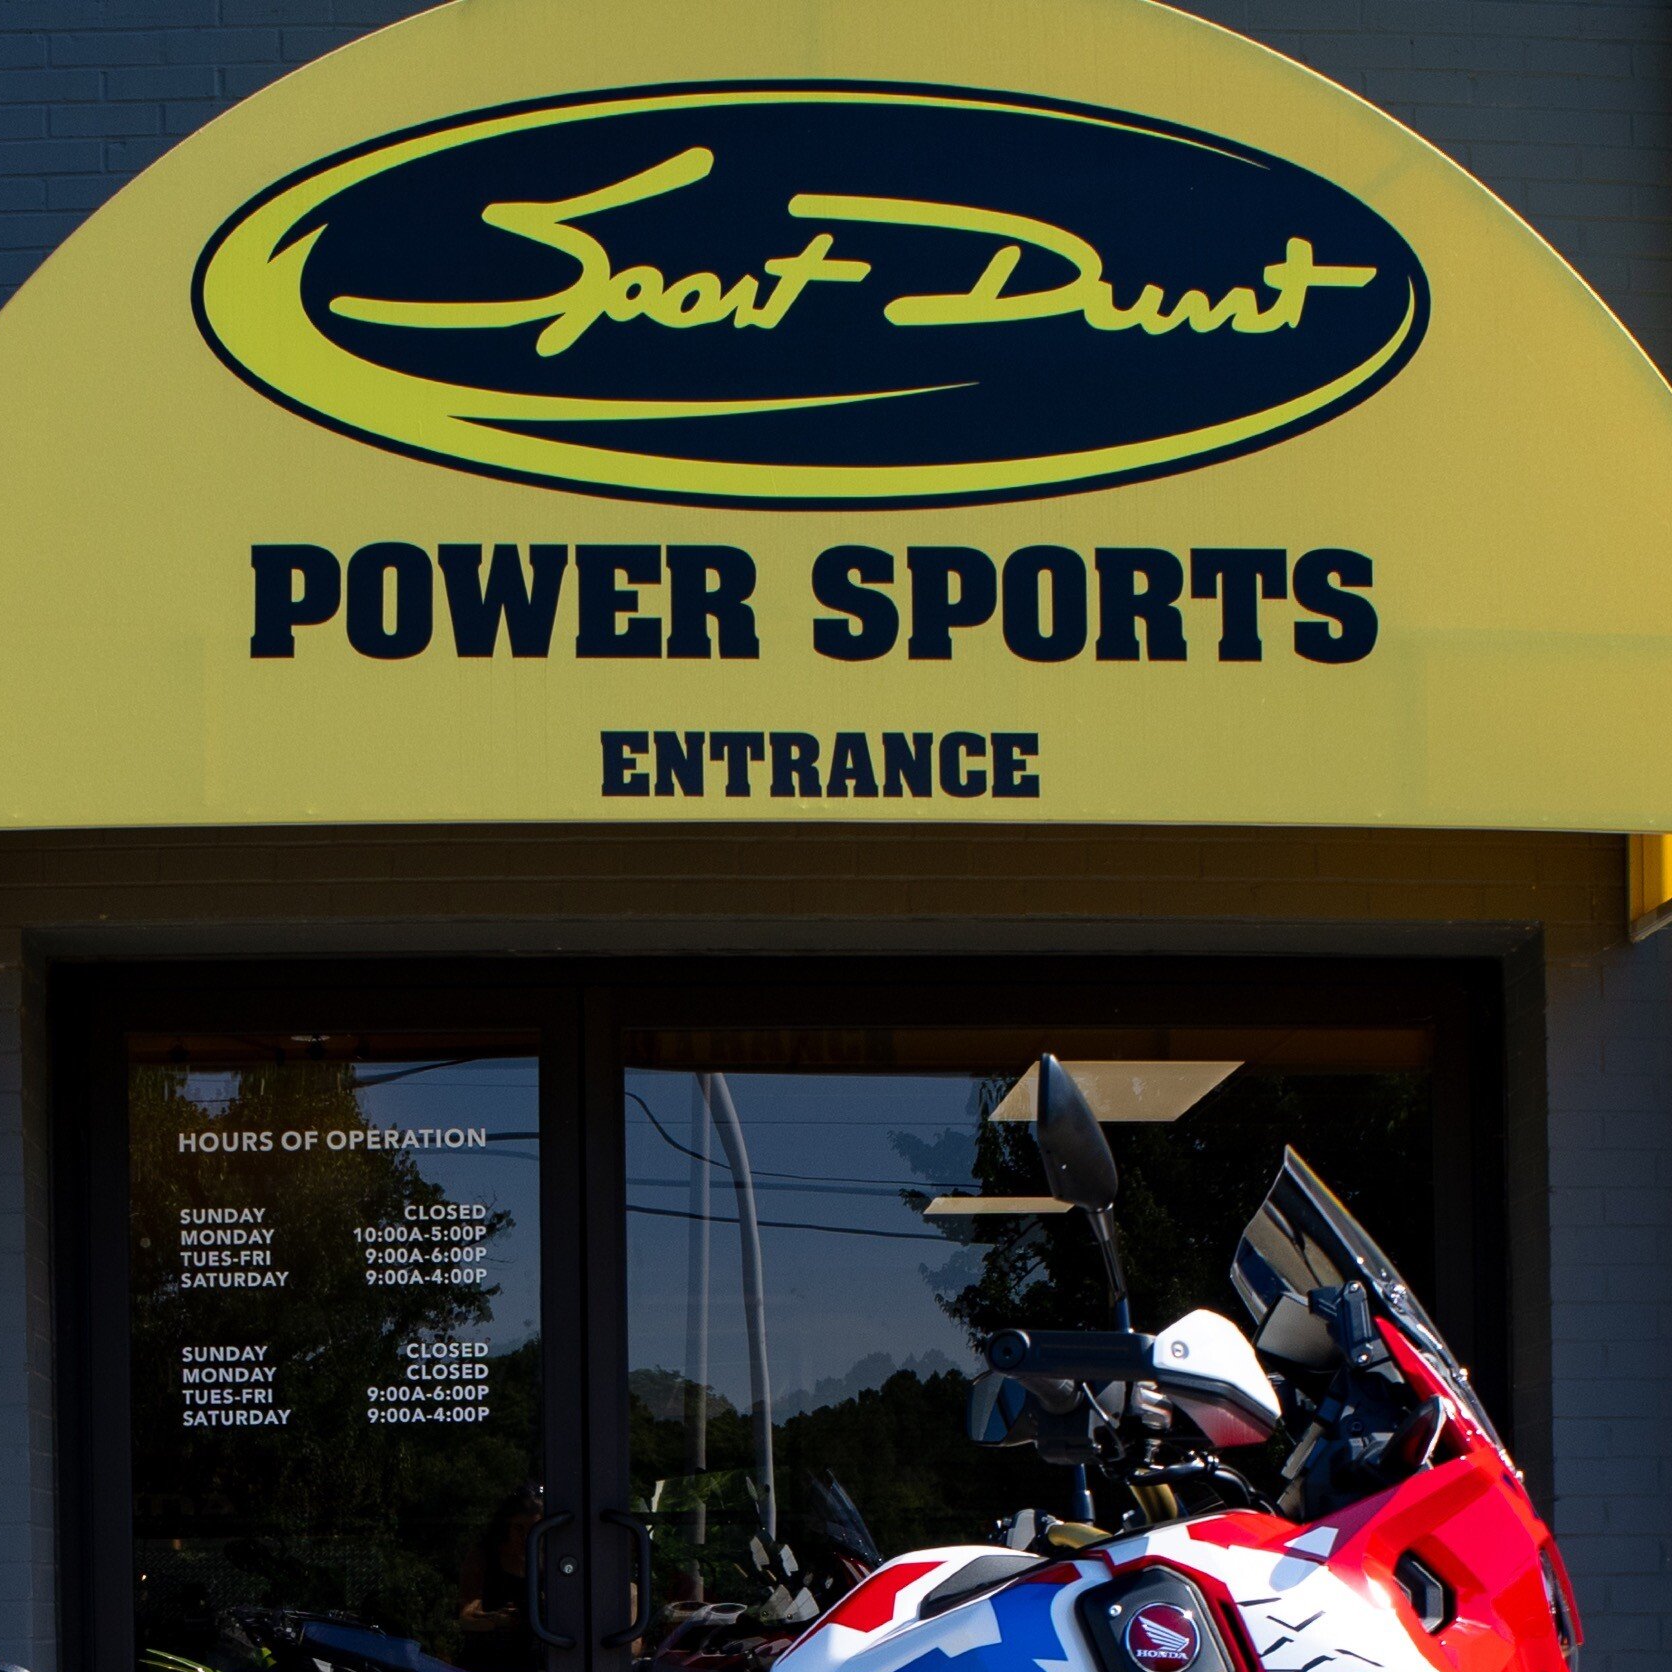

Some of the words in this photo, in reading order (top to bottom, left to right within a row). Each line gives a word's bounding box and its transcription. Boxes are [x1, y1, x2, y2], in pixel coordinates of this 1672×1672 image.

[250, 541, 760, 660] POWER
[811, 544, 1379, 665] SPORTS
[600, 730, 1040, 798] ENTRANCE
[178, 1131, 273, 1153] HOURS
[281, 1130, 318, 1151] OF
[327, 1127, 487, 1151] OPERATION
[180, 1208, 266, 1225] SUNDAY
[404, 1204, 487, 1221] CLOSED
[180, 1229, 275, 1246] MONDAY
[353, 1226, 487, 1243] 10:00A-5:00P
[181, 1251, 271, 1267] TUES-FRI
[366, 1247, 488, 1264] 9:00A-6:00P
[181, 1271, 289, 1288] SATURDAY
[366, 1269, 488, 1286] 9:00A-4:00P
[182, 1345, 268, 1362] SUNDAY
[406, 1342, 489, 1359] CLOSED
[182, 1367, 277, 1384] MONDAY
[406, 1364, 489, 1380] CLOSED
[183, 1388, 273, 1405] TUES-FRI
[367, 1385, 490, 1402] 9:00A-6:00P
[183, 1409, 291, 1426] SATURDAY
[367, 1407, 490, 1424] 9:00A-4:00P
[1136, 1649, 1189, 1660] HONDA
